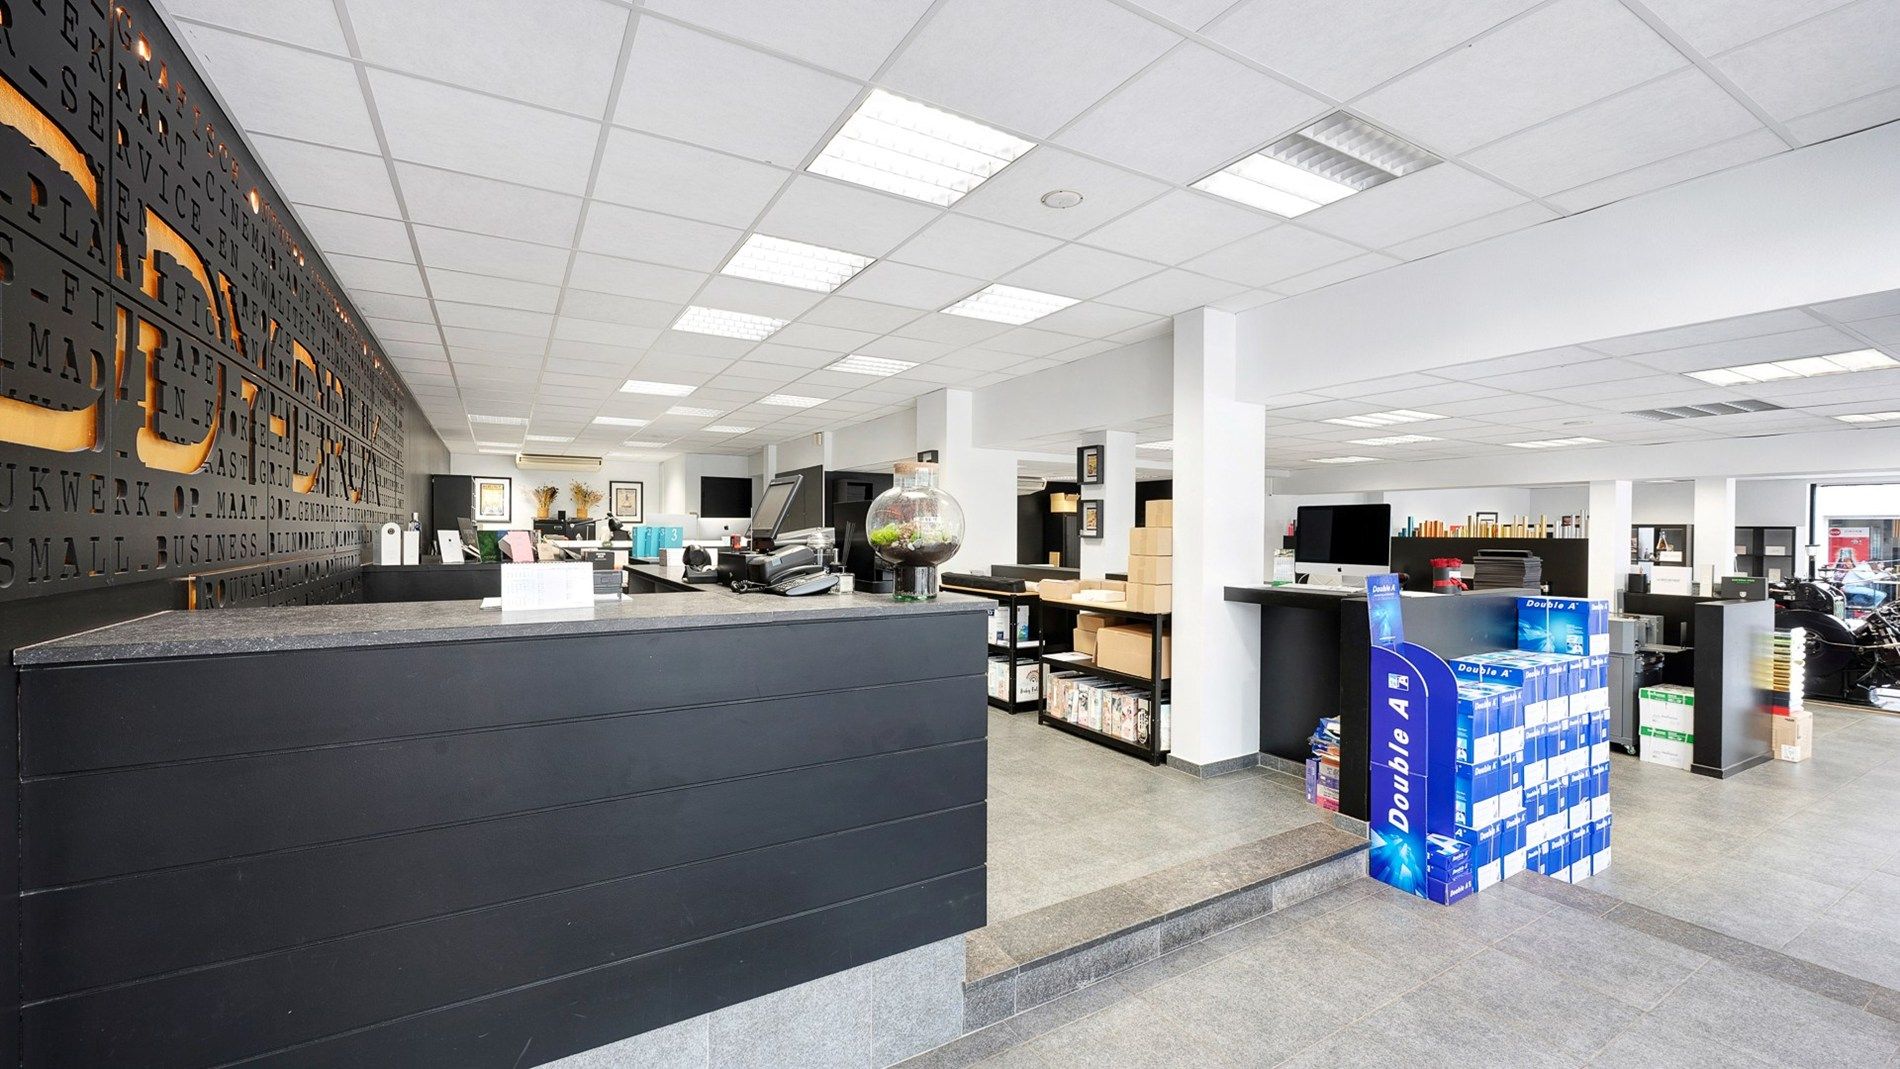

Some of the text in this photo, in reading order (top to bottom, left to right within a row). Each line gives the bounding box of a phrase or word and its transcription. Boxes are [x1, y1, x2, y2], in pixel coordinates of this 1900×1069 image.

[60, 58, 200, 236] SERVICE
[218, 225, 239, 273] EN
[173, 484, 199, 518] OP
[216, 491, 256, 520] MAAT
[671, 528, 678, 542] 3
[0, 535, 128, 588] SMALL
[156, 532, 256, 569] BUSINESS
[269, 531, 325, 554] BLINDDRUK
[1525, 599, 1565, 609] Double
[1458, 664, 1497, 676] Double
[1388, 697, 1410, 720] A
[1388, 728, 1410, 834] Double
